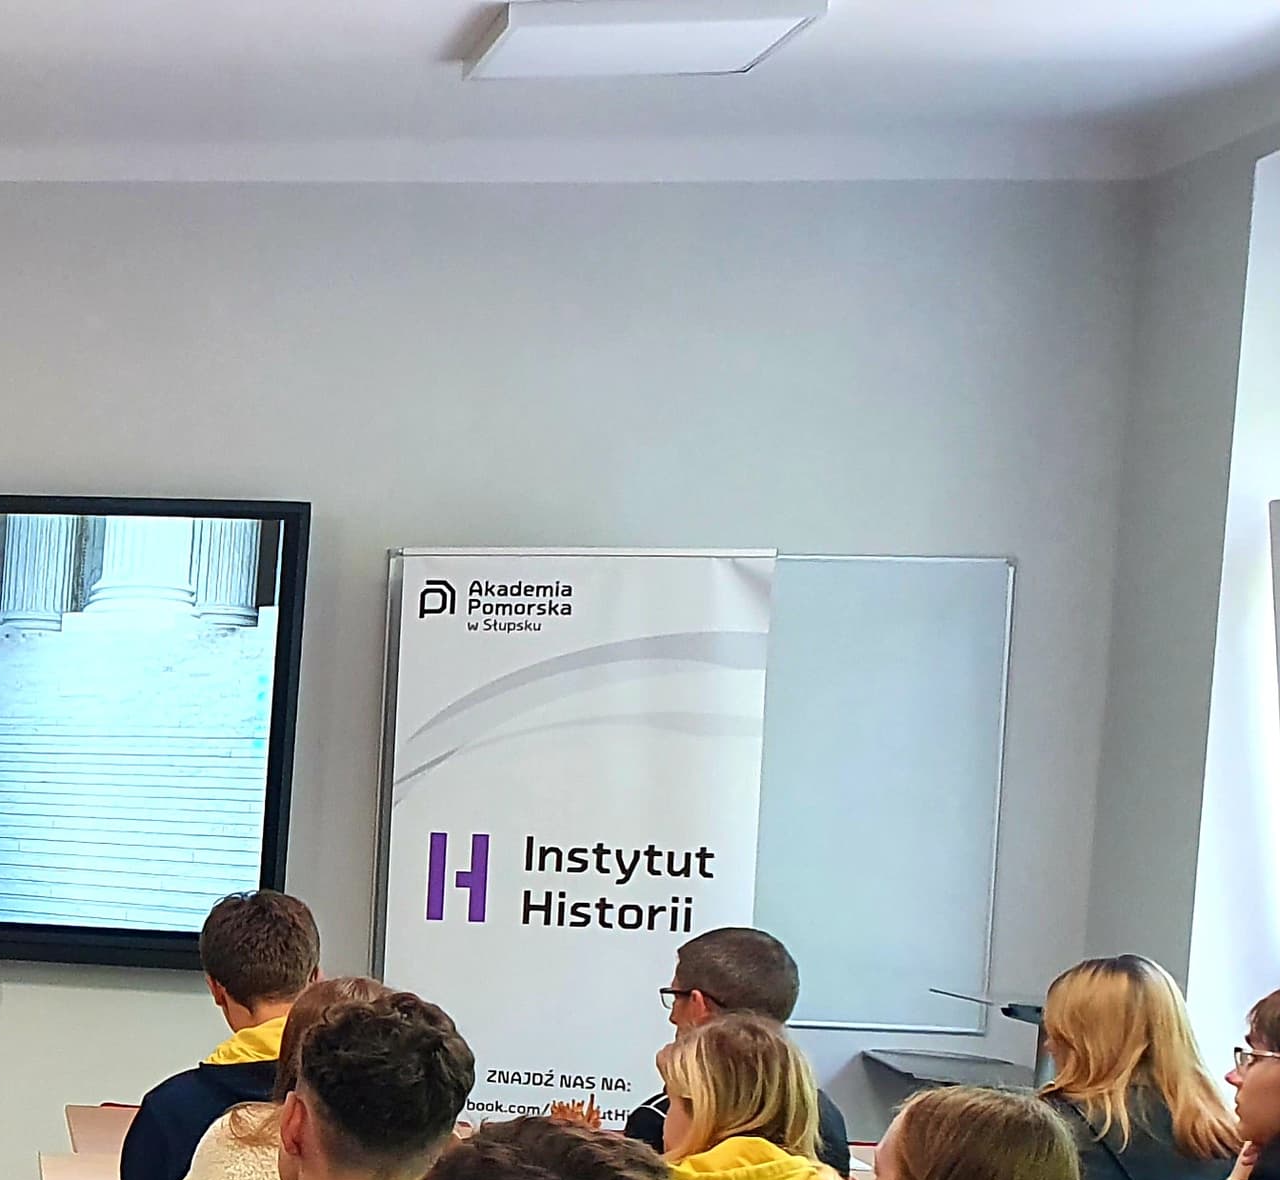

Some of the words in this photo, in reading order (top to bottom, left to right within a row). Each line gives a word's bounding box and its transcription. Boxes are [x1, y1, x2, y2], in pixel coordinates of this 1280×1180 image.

[468, 580, 573, 597] Akademia
[467, 599, 572, 616] Pomorska
[467, 621, 479, 631] w
[483, 619, 542, 633] Słupsku
[524, 835, 716, 885] Instytut
[522, 890, 693, 932] Historii
[486, 1069, 555, 1087] ZNAJDŹ
[559, 1075, 596, 1090] NAS
[601, 1077, 632, 1092] NA:
